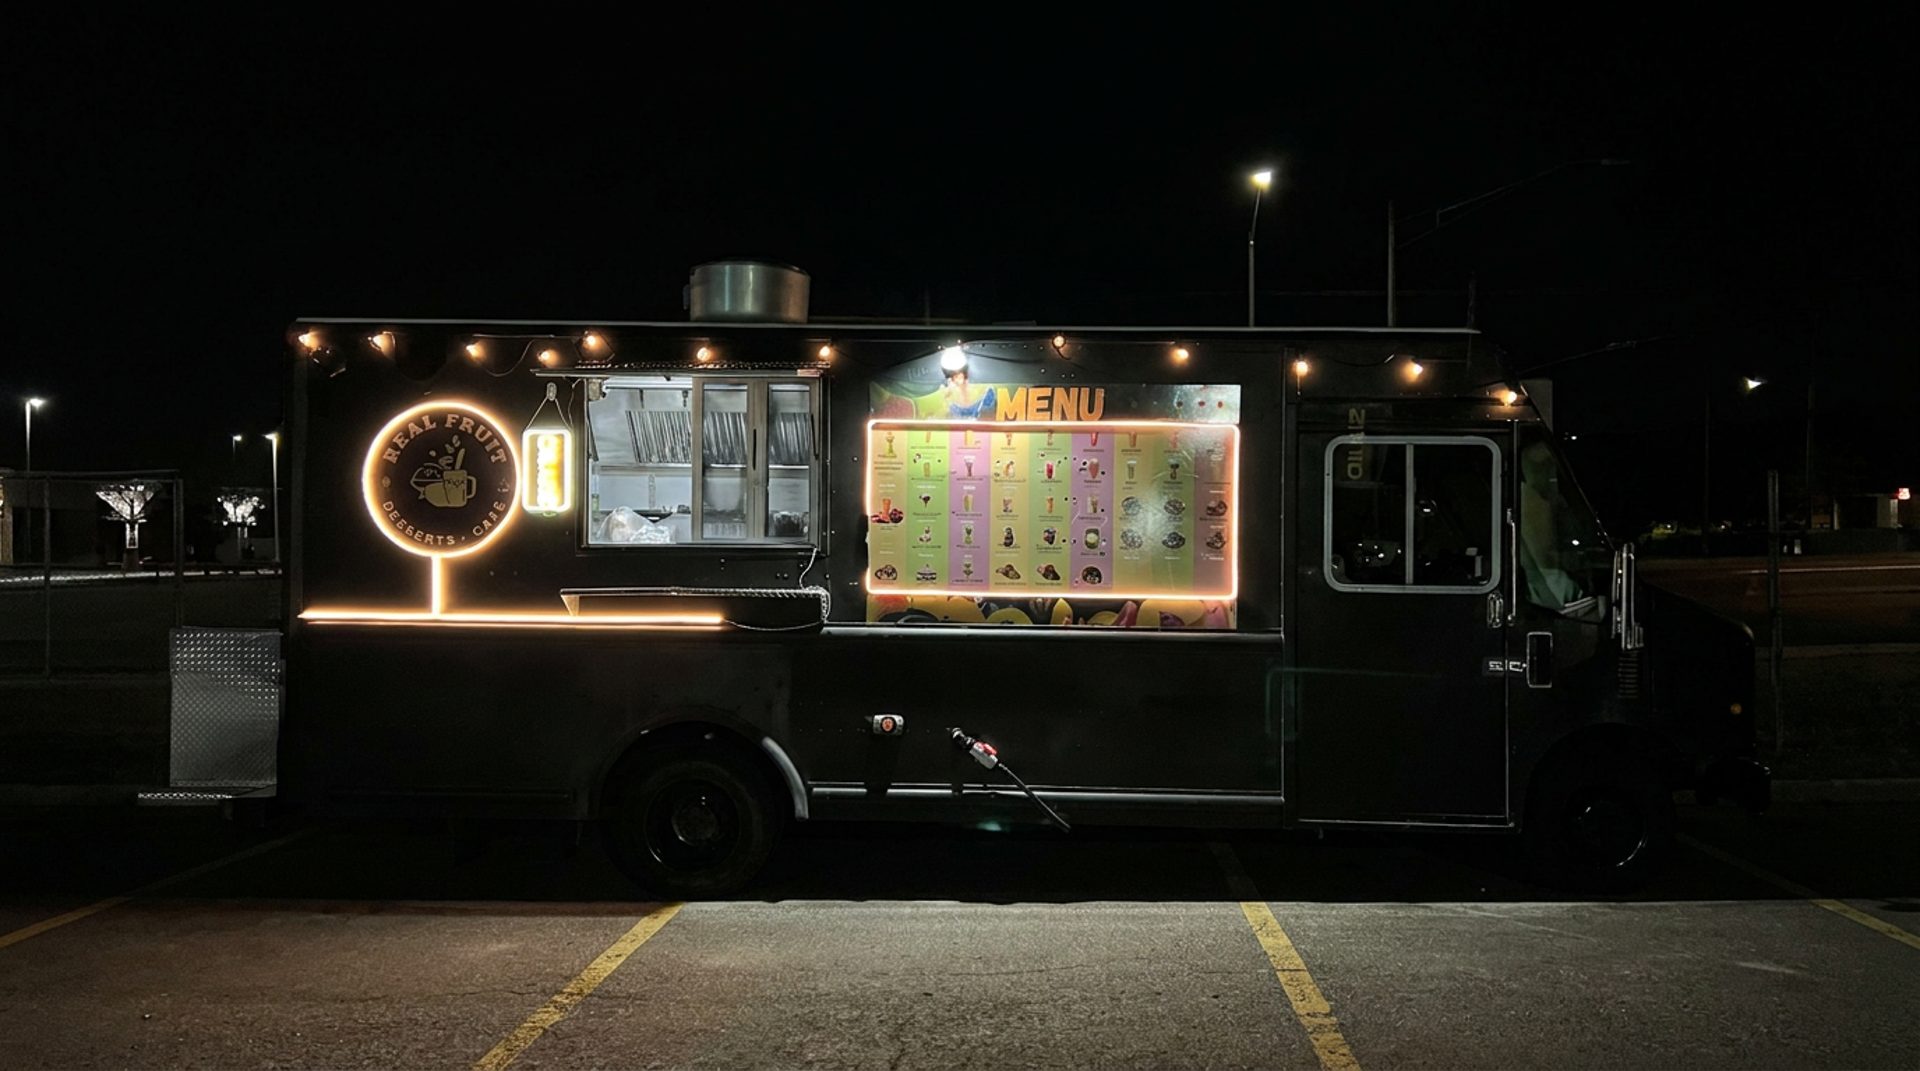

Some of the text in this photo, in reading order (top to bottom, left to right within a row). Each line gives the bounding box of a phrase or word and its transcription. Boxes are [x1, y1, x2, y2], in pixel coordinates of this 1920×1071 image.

[996, 387, 1105, 421] MENU
[383, 413, 507, 464] REAL FRUIT
